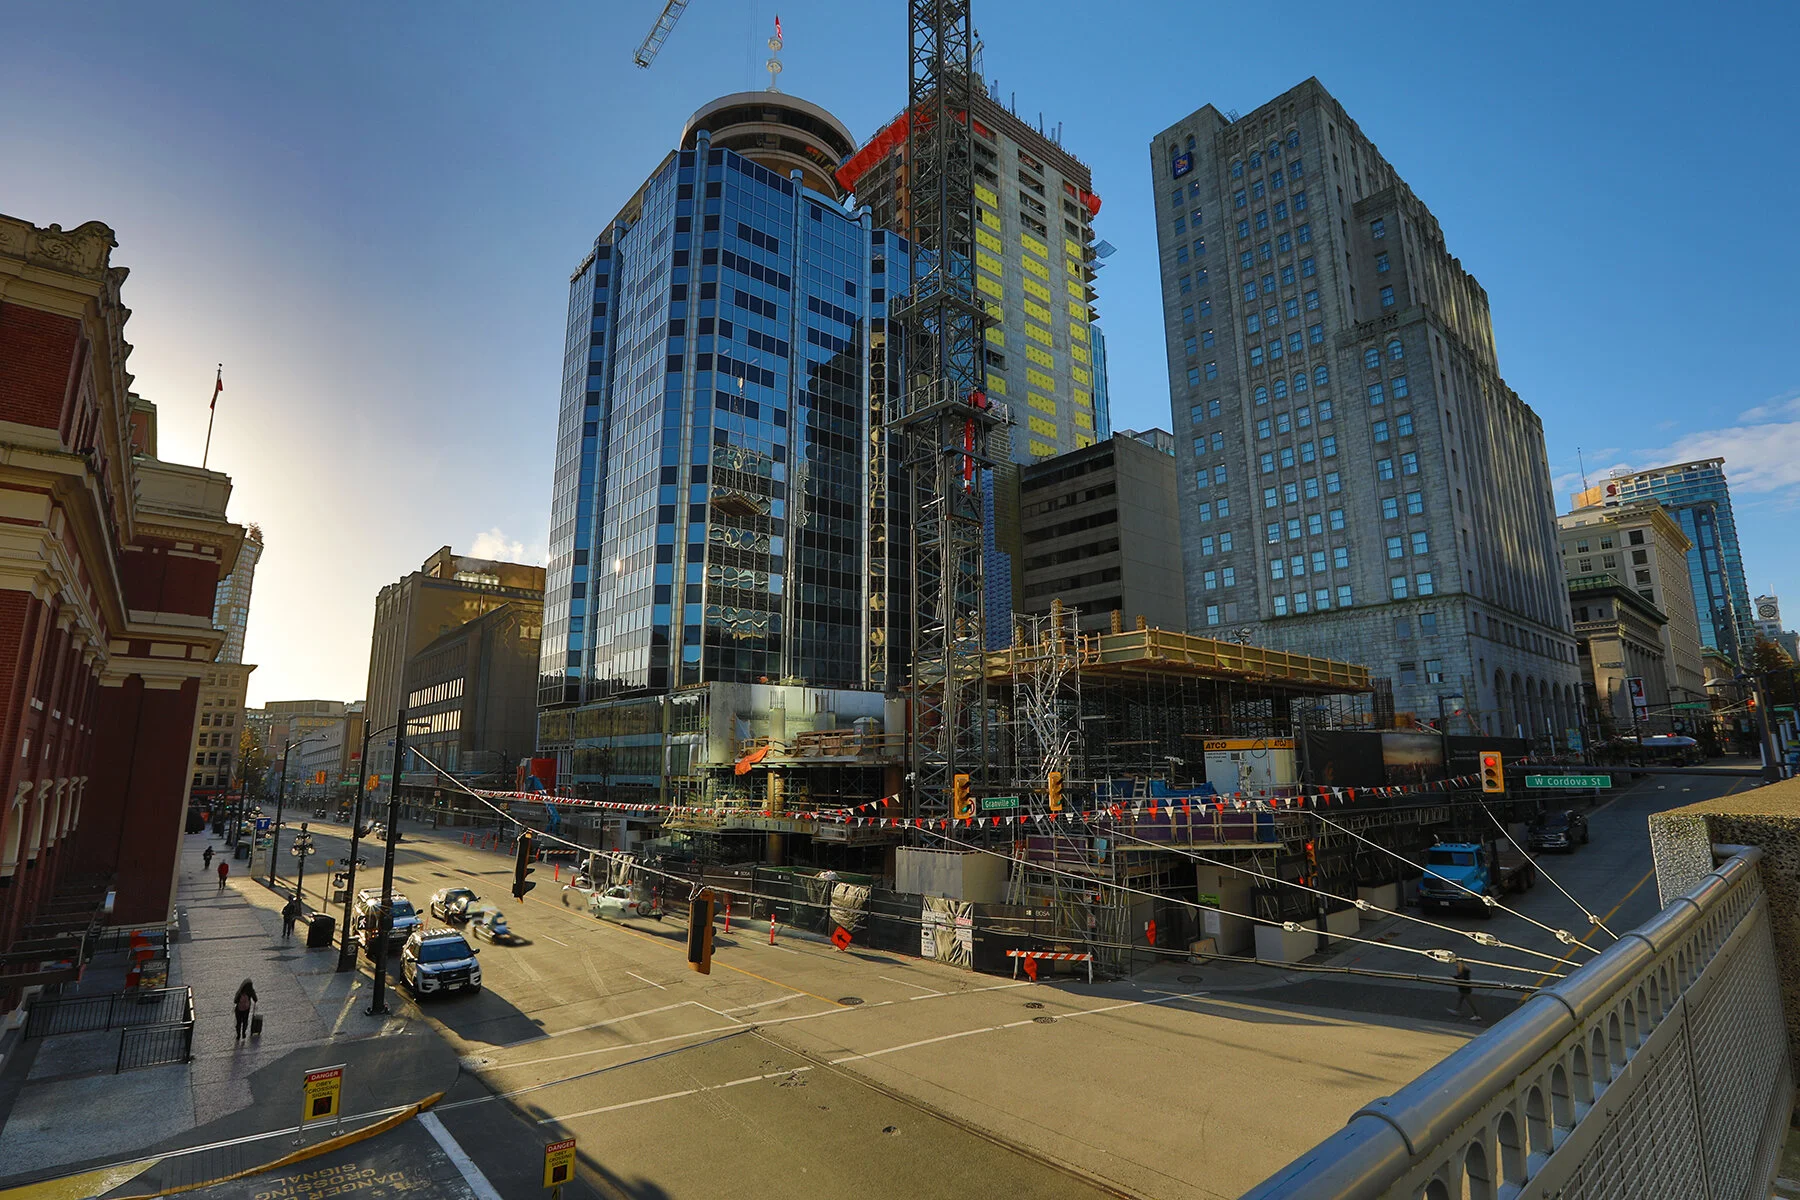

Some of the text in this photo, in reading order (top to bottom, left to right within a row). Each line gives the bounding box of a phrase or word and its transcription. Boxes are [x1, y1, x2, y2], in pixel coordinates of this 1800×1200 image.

[1547, 778, 1587, 786] Cordova
[1591, 778, 1601, 786] St
[984, 800, 1009, 808] Granville
[260, 819, 268, 828] T
[311, 1070, 339, 1081] DANGER
[308, 1084, 339, 1094] CROSSING
[315, 1080, 333, 1088] OBEY
[548, 1141, 575, 1152] DANGER
[270, 1163, 357, 1186] SIGNAL
[254, 1168, 376, 1200] CROSSING
[308, 1171, 405, 1200] DANGER
